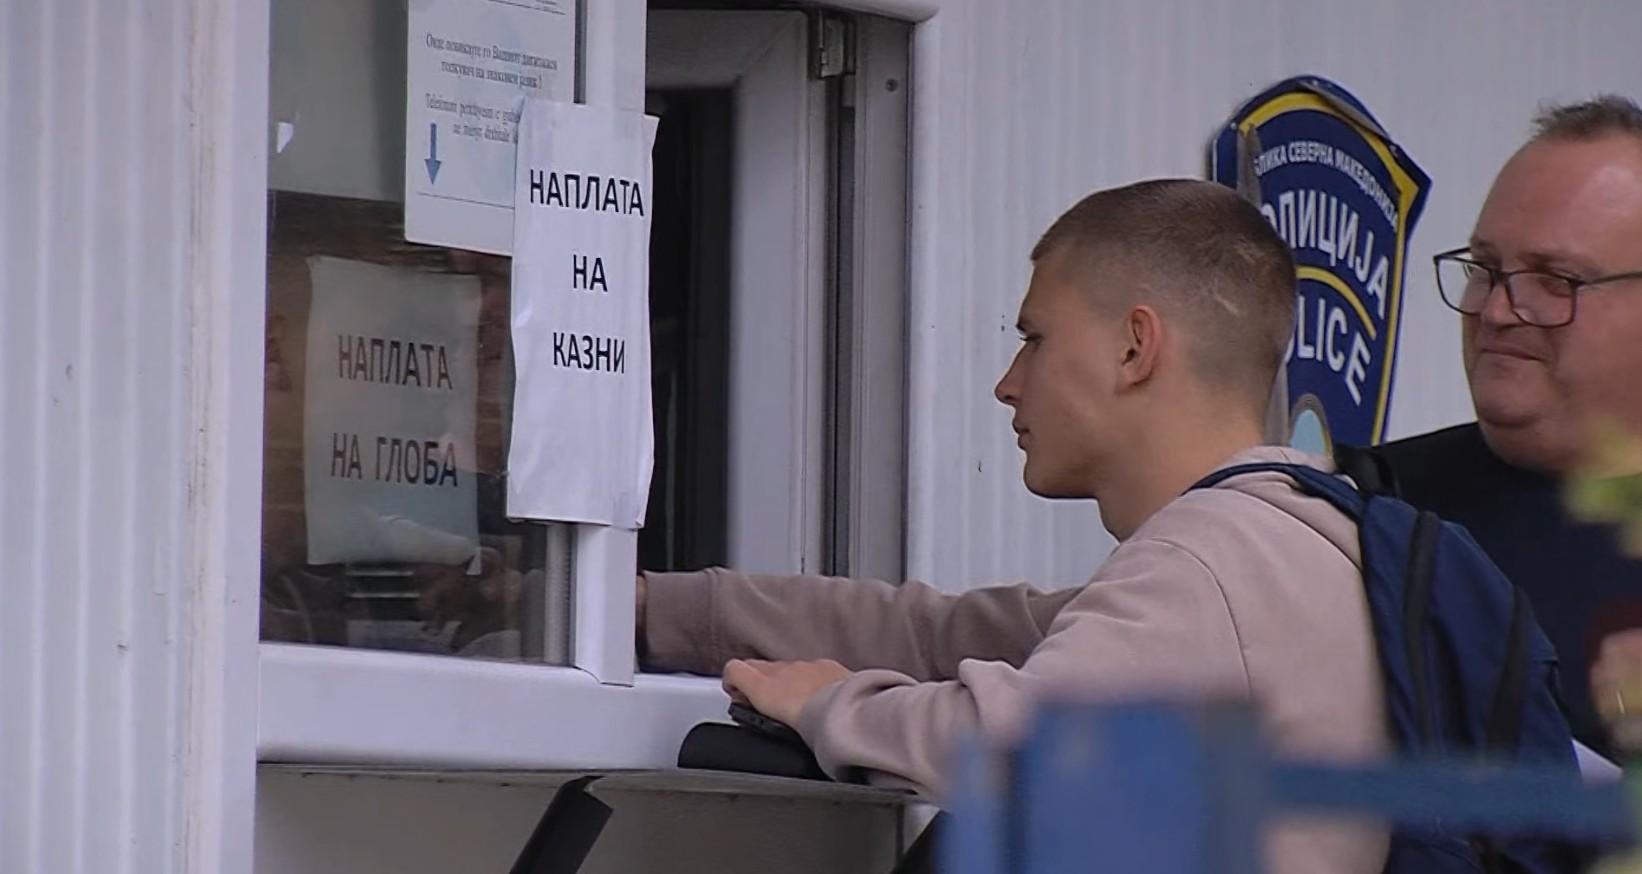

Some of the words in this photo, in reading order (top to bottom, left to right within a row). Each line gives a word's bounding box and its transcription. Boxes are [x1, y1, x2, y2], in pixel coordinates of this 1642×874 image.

[530, 169, 645, 217] НАПЛАТА
[1288, 141, 1334, 166] СЕВЕРНА
[1335, 149, 1399, 232] МАКЕДОНИЈА
[573, 254, 608, 292] НА
[338, 334, 453, 390] НАПЛАТА
[553, 331, 626, 374] КАЗНИ
[1284, 295, 1371, 406] LICE
[331, 432, 363, 480] НА
[375, 436, 458, 488] ГЛОБА
